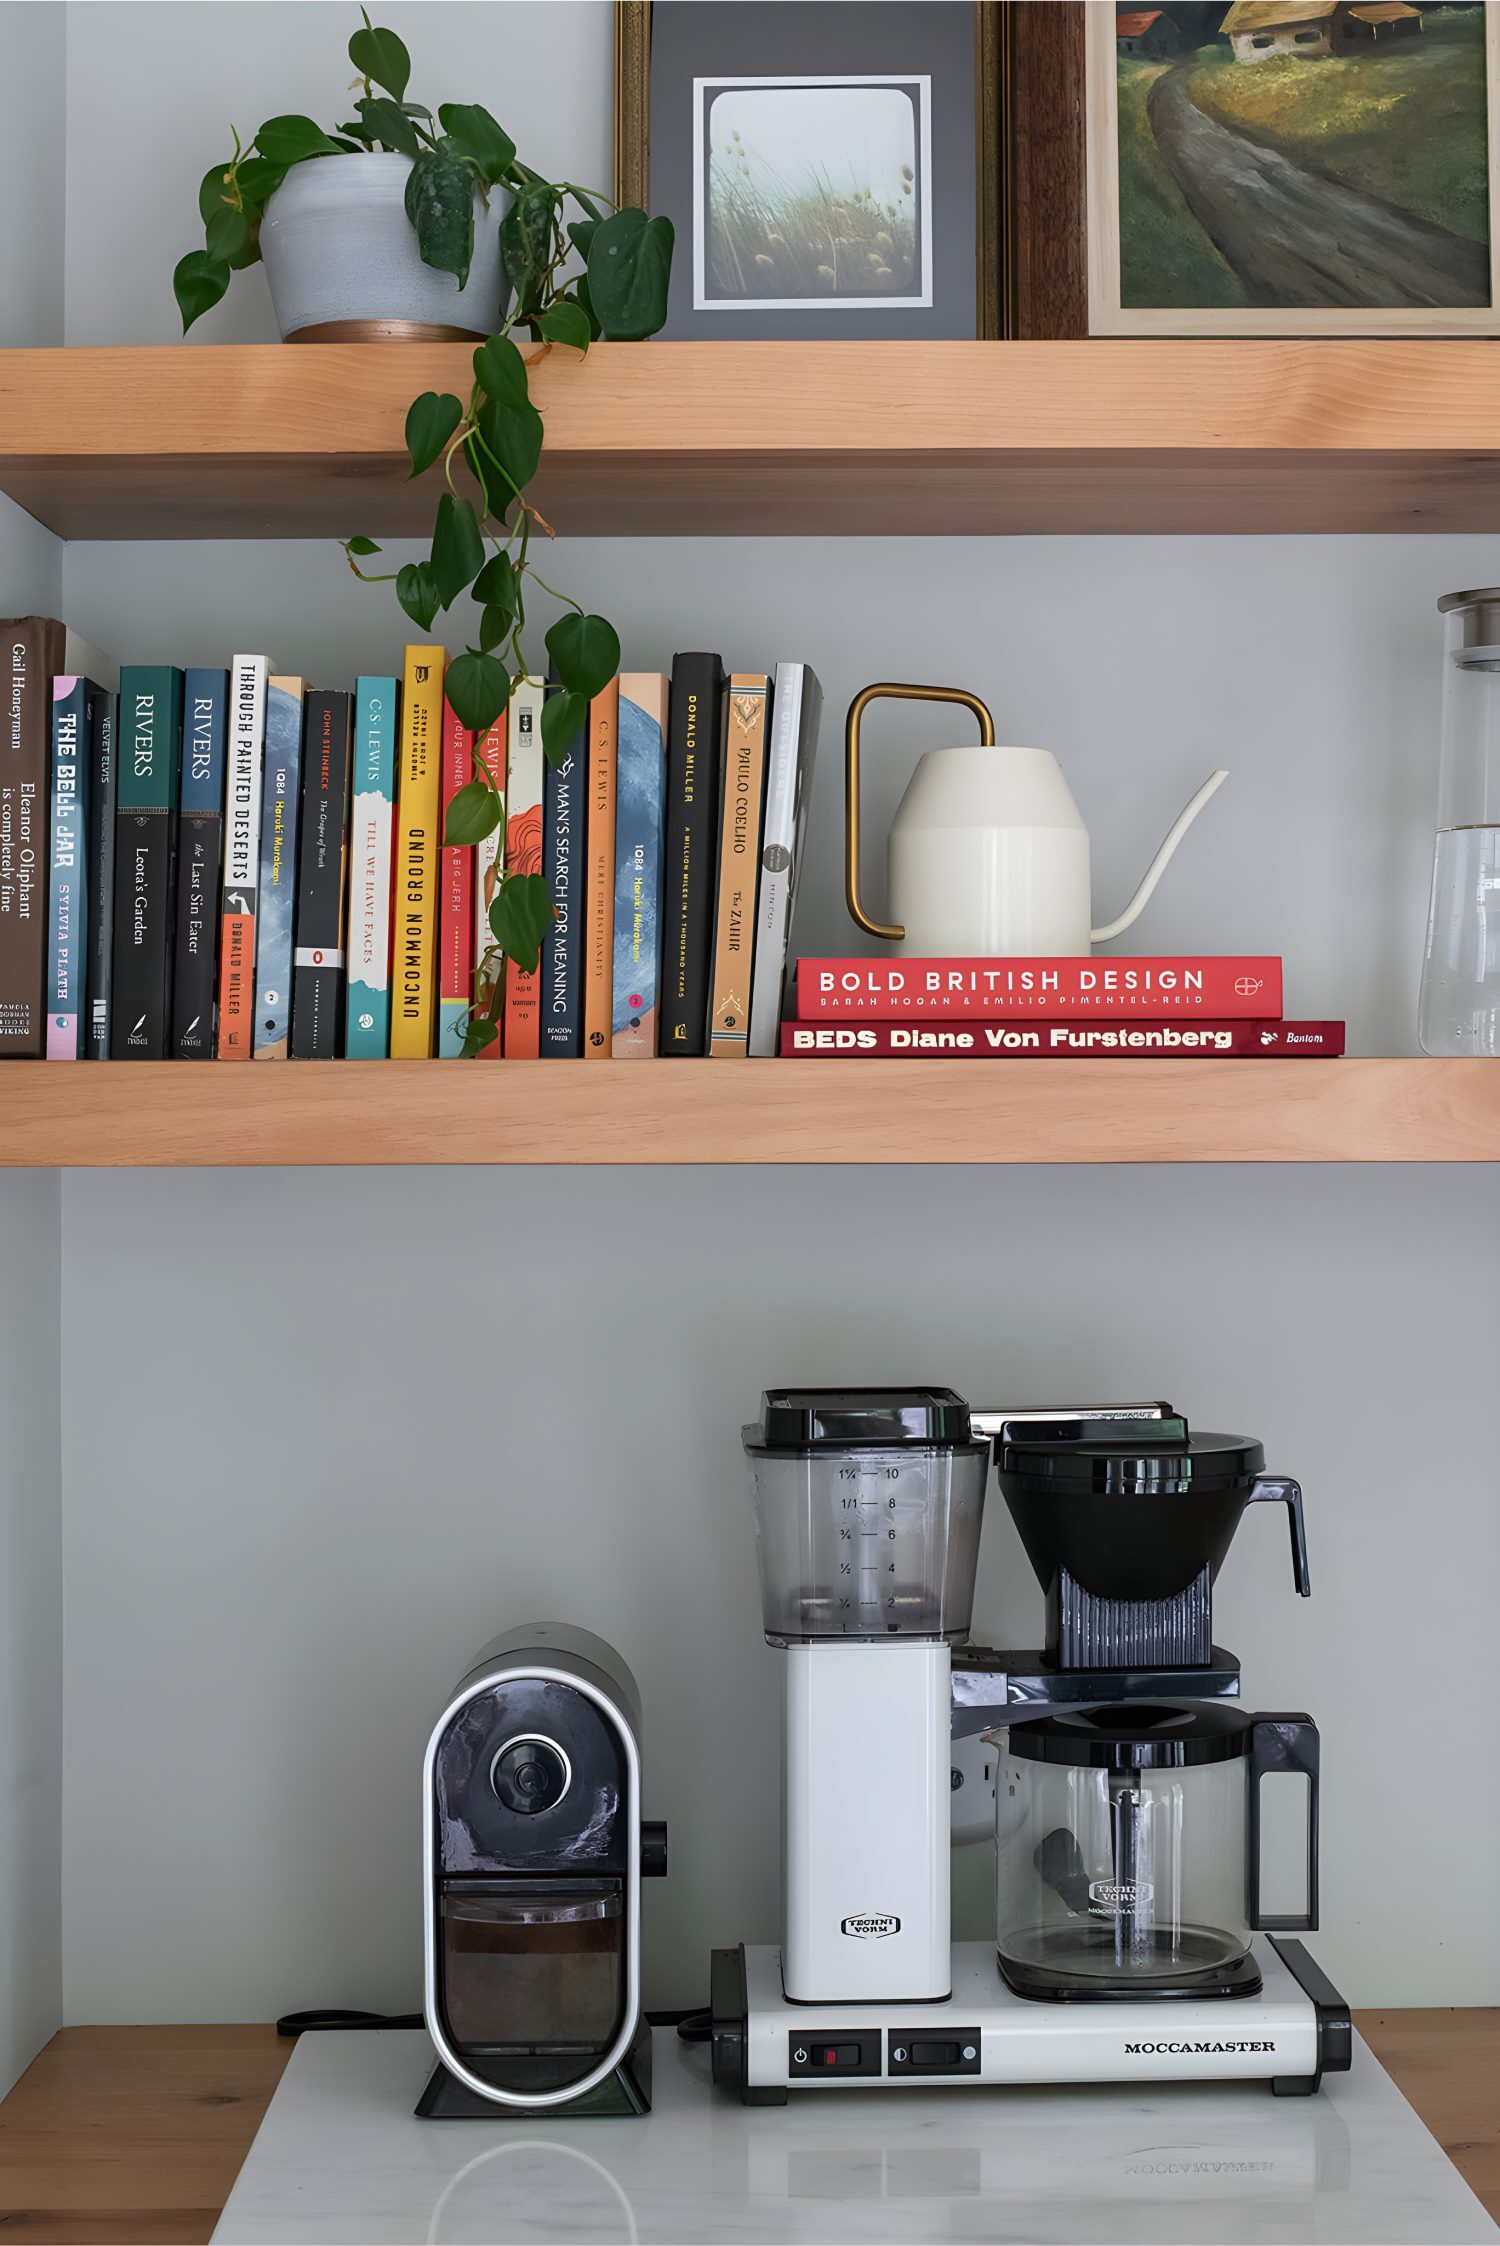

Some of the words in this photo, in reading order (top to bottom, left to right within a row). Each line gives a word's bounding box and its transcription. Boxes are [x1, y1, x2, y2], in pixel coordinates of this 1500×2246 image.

[12, 643, 26, 672] Gail
[8, 677, 25, 749] Honeyman
[238, 665, 256, 733] THROUGH
[57, 713, 77, 757] THE
[101, 716, 111, 754] VELVET
[134, 694, 154, 777] RIVERS
[191, 697, 213, 780] RIVERS
[323, 710, 331, 736] JOHN
[687, 695, 697, 749] DONALD
[101, 756, 110, 783] ELVIS
[235, 740, 252, 803] PAINTED
[321, 739, 331, 790] STEINBECK
[368, 730, 380, 781] LEWIS
[454, 753, 463, 787] INNER
[736, 747, 751, 792] PAULO
[2, 788, 14, 799] is
[57, 764, 76, 817] BELL
[275, 768, 286, 794] 1Q84
[598, 758, 607, 811] LEWIS
[684, 754, 695, 803] MILLER
[20, 782, 36, 843] Eleanor
[274, 800, 285, 834] Haruki
[317, 813, 327, 838] Grapes
[319, 800, 328, 813] The
[557, 784, 571, 834] MAN'S
[734, 797, 748, 854] COELHO
[0, 804, 15, 880] completely
[54, 825, 75, 869] JAR
[195, 843, 204, 857] the
[232, 810, 250, 879] DESERTS
[316, 838, 327, 847] of
[367, 820, 377, 850] TILL
[135, 848, 149, 892] Leota's
[191, 862, 205, 889] Last
[272, 837, 283, 886] Murakami
[366, 856, 376, 876] WE
[407, 828, 425, 902] GROUND
[453, 859, 462, 877] BIG
[555, 838, 570, 898] SEARCH
[634, 844, 644, 871] 1Q84
[1, 885, 15, 912] fine
[16, 849, 35, 919] Oliphant
[190, 893, 204, 914] Sin
[364, 882, 375, 917] HAVE
[633, 876, 643, 911] Haruki
[58, 884, 69, 941] SYLVIA
[134, 896, 148, 945] Garden
[554, 903, 569, 934] FOR
[681, 901, 688, 911] IN
[189, 920, 203, 954] Eater
[230, 922, 243, 967] DONALD
[363, 923, 374, 964] FACES
[632, 913, 643, 963] Murakami
[679, 923, 687, 967] THOUSAND
[729, 910, 742, 951] ZAHIR
[57, 948, 69, 1000] PLATH
[403, 913, 423, 1018] UNCOMMON
[553, 938, 567, 1013] MEANING
[820, 972, 905, 992] BOLD
[926, 970, 1059, 991] BRITISH
[1080, 970, 1203, 990] DESIGN
[228, 973, 241, 1015] MILLER
[820, 997, 877, 1006] SARAH
[891, 997, 950, 1005] HOGAN
[963, 996, 970, 1005] &
[983, 996, 1046, 1005] EMILIO
[1059, 995, 1203, 1005] PIMENTEL-REID
[793, 1029, 877, 1049] BEDS
[890, 1029, 975, 1048] Diane
[985, 1028, 1040, 1048] Von
[1050, 1027, 1233, 1049] Furstenberg
[886, 1468, 899, 1479] 10
[842, 1498, 857, 1509] 1/1
[888, 1498, 896, 1508] 8
[888, 1529, 896, 1540] 6
[888, 1563, 895, 1573] 4
[888, 1598, 895, 1608] 2
[1124, 2041, 1276, 2054] MOCCAMASTER
